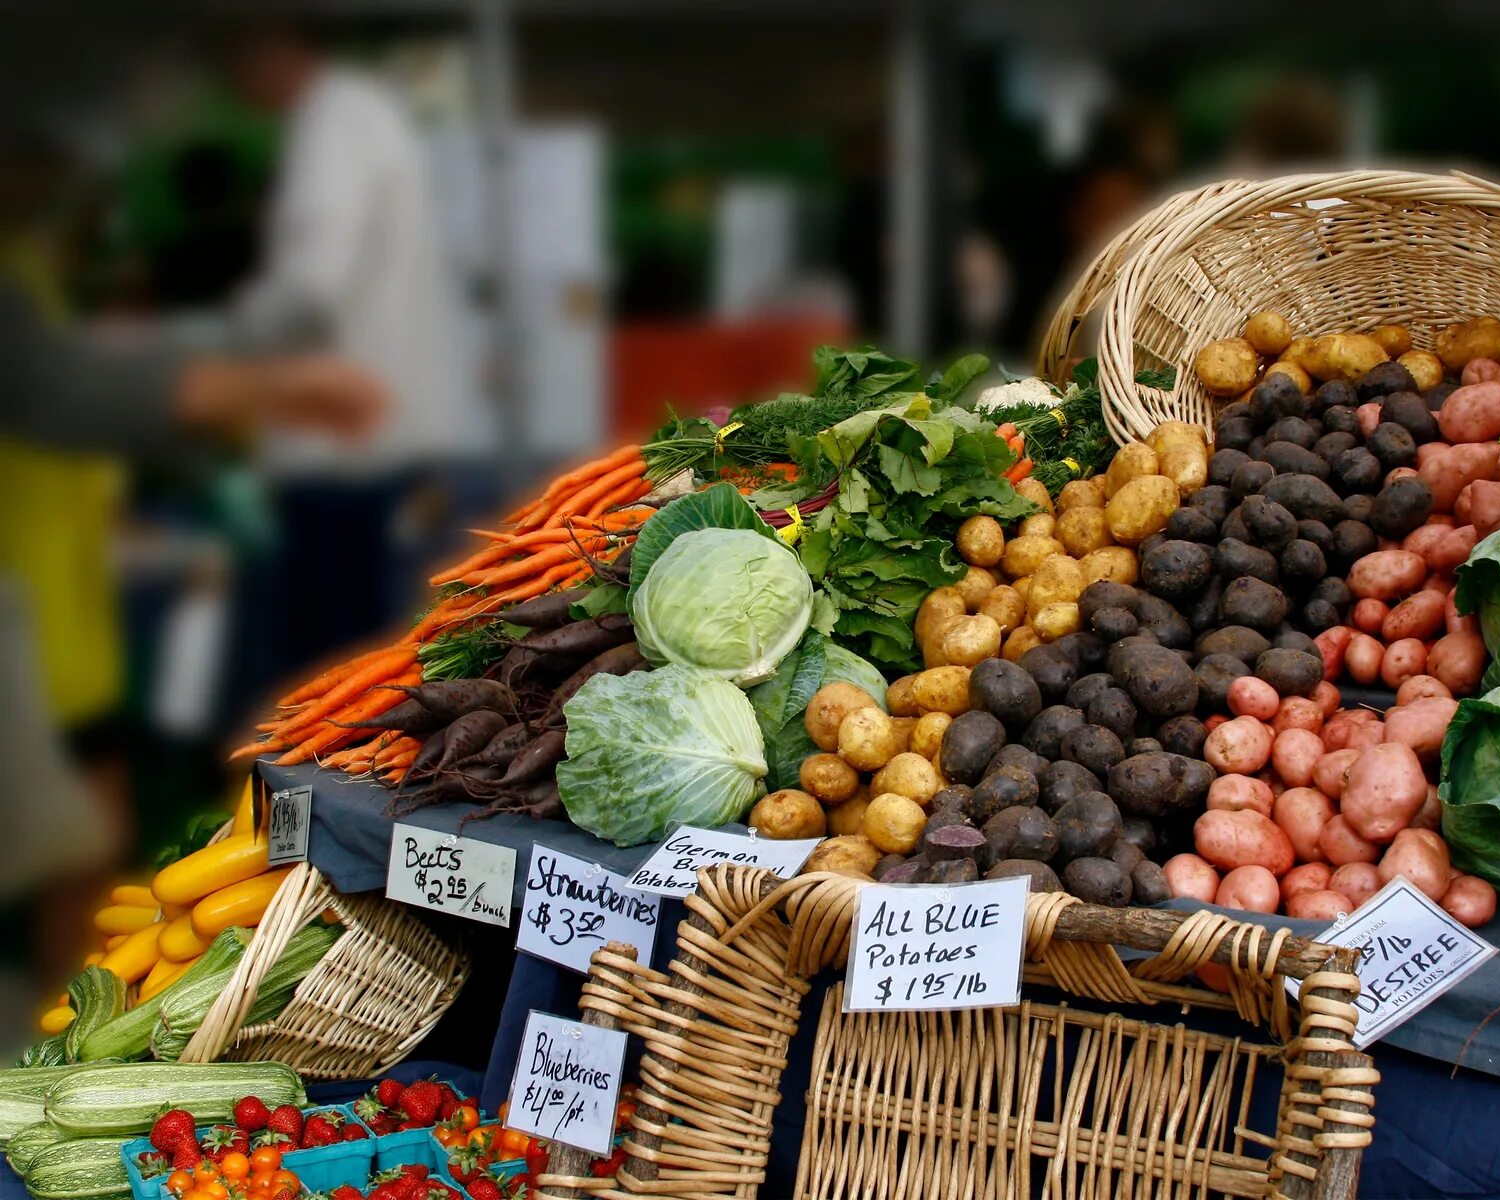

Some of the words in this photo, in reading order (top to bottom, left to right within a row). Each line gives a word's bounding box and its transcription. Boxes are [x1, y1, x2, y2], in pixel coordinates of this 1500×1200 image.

[405, 837, 464, 871] Beets
[665, 835, 758, 863] German
[527, 856, 657, 926] Strawberries
[631, 869, 699, 890] Potatoes
[864, 900, 914, 938] ALL
[924, 903, 1000, 936] BLUE
[1366, 918, 1388, 936] FARM
[865, 941, 978, 970] Potatoes
[1353, 932, 1460, 1015] DESIREE
[1363, 1008, 1389, 1029] ORGANIC
[1391, 967, 1446, 1008] POTATOES
[1449, 949, 1474, 967] ORGANIC
[530, 1031, 612, 1091] Blueberries
